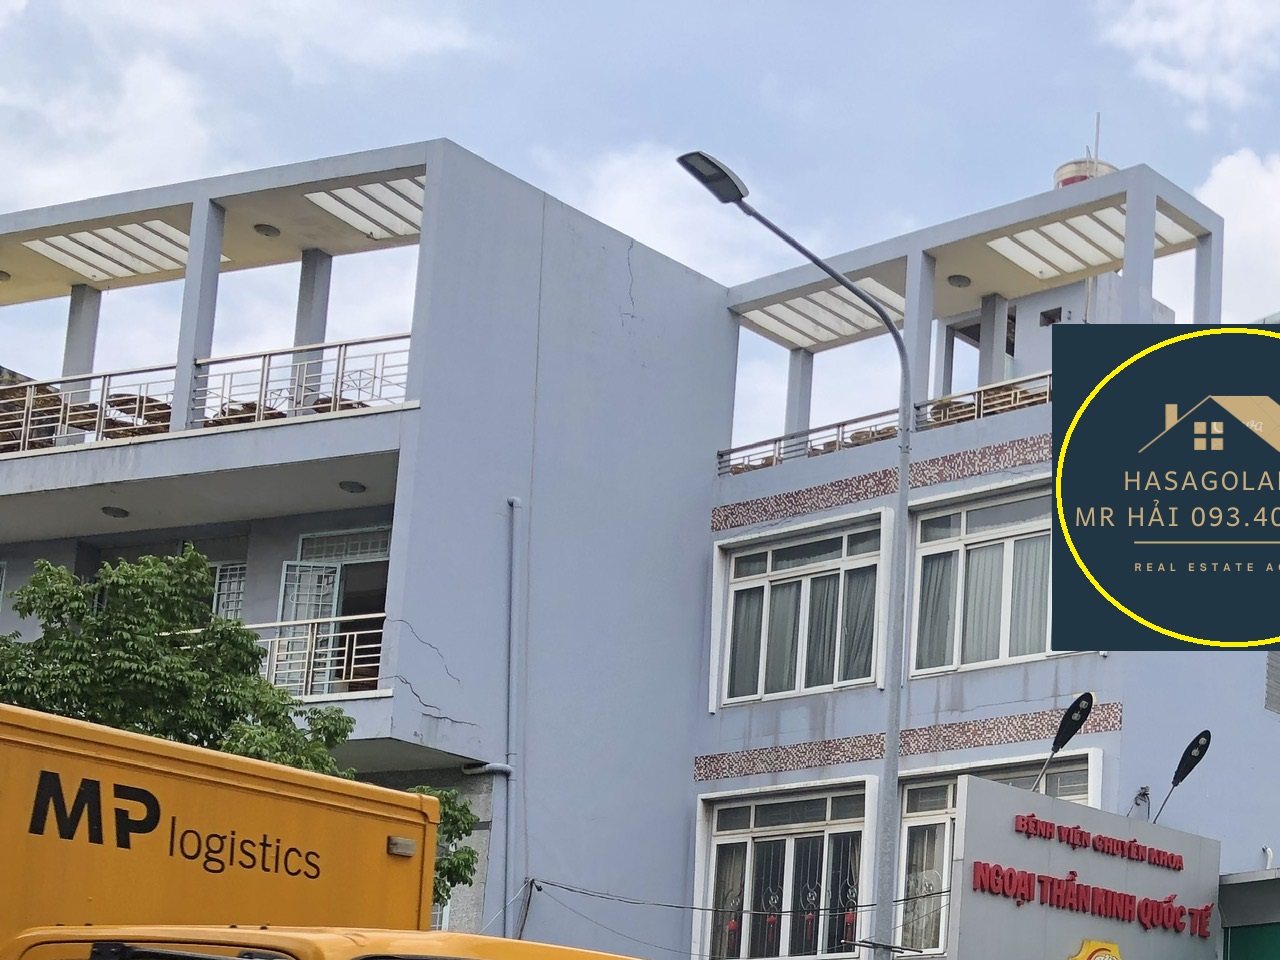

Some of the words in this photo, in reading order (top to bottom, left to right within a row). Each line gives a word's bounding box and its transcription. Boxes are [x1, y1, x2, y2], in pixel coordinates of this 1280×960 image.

[28, 770, 161, 849] MP
[169, 816, 320, 879] logistics
[1014, 813, 1055, 839] BỆNH
[1057, 824, 1091, 850] VIỆN
[1092, 834, 1147, 862] CHUYÊN
[1148, 847, 1184, 871] KHOA
[973, 860, 1036, 906] NGOẠI
[1037, 870, 1091, 912] THẦN
[1090, 886, 1137, 922] KINH
[1137, 894, 1187, 933] QUỐC
[1187, 903, 1215, 938] TẾ
